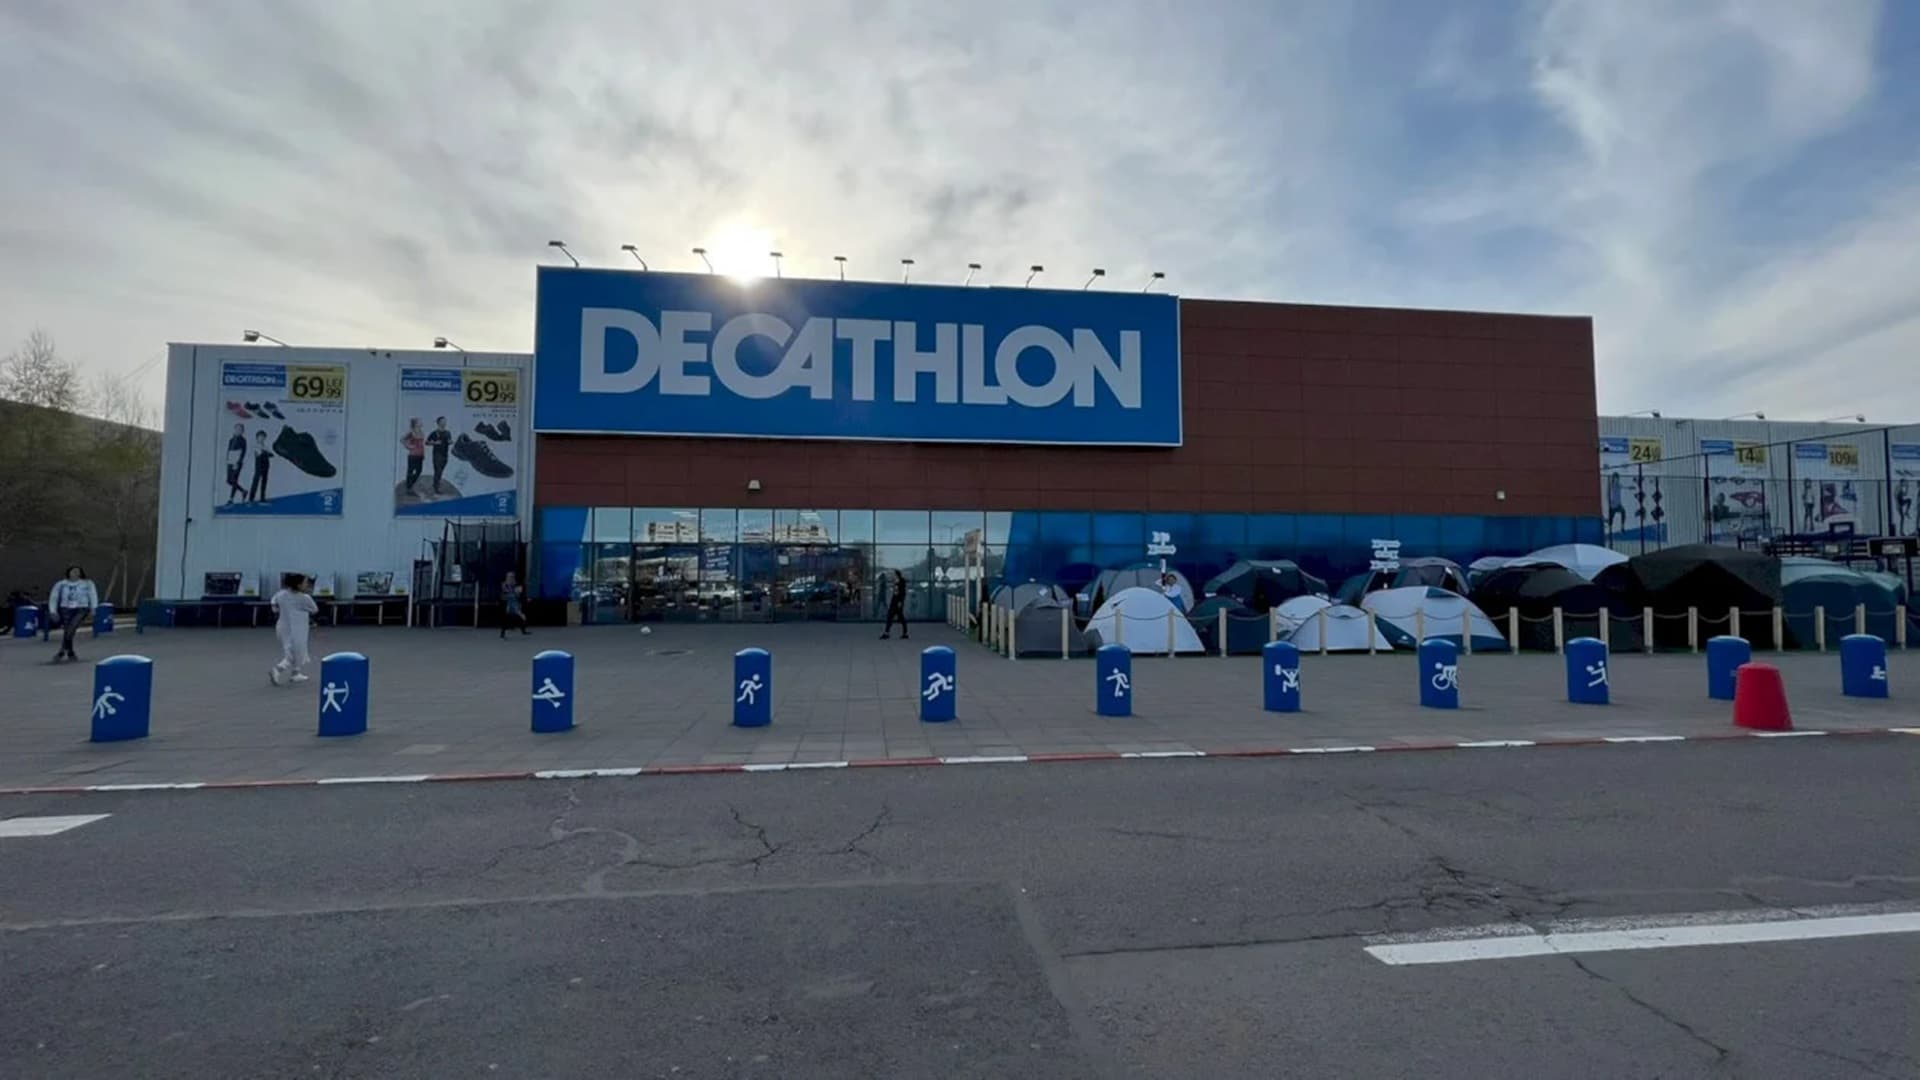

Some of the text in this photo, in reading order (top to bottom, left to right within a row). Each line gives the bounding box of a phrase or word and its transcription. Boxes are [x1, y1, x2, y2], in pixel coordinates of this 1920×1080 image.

[579, 306, 1141, 409] DECATHLON
[293, 376, 324, 398] 69
[326, 387, 341, 398] 99
[467, 380, 499, 402] 69
[1632, 444, 1651, 460] 24
[323, 494, 333, 506] 2
